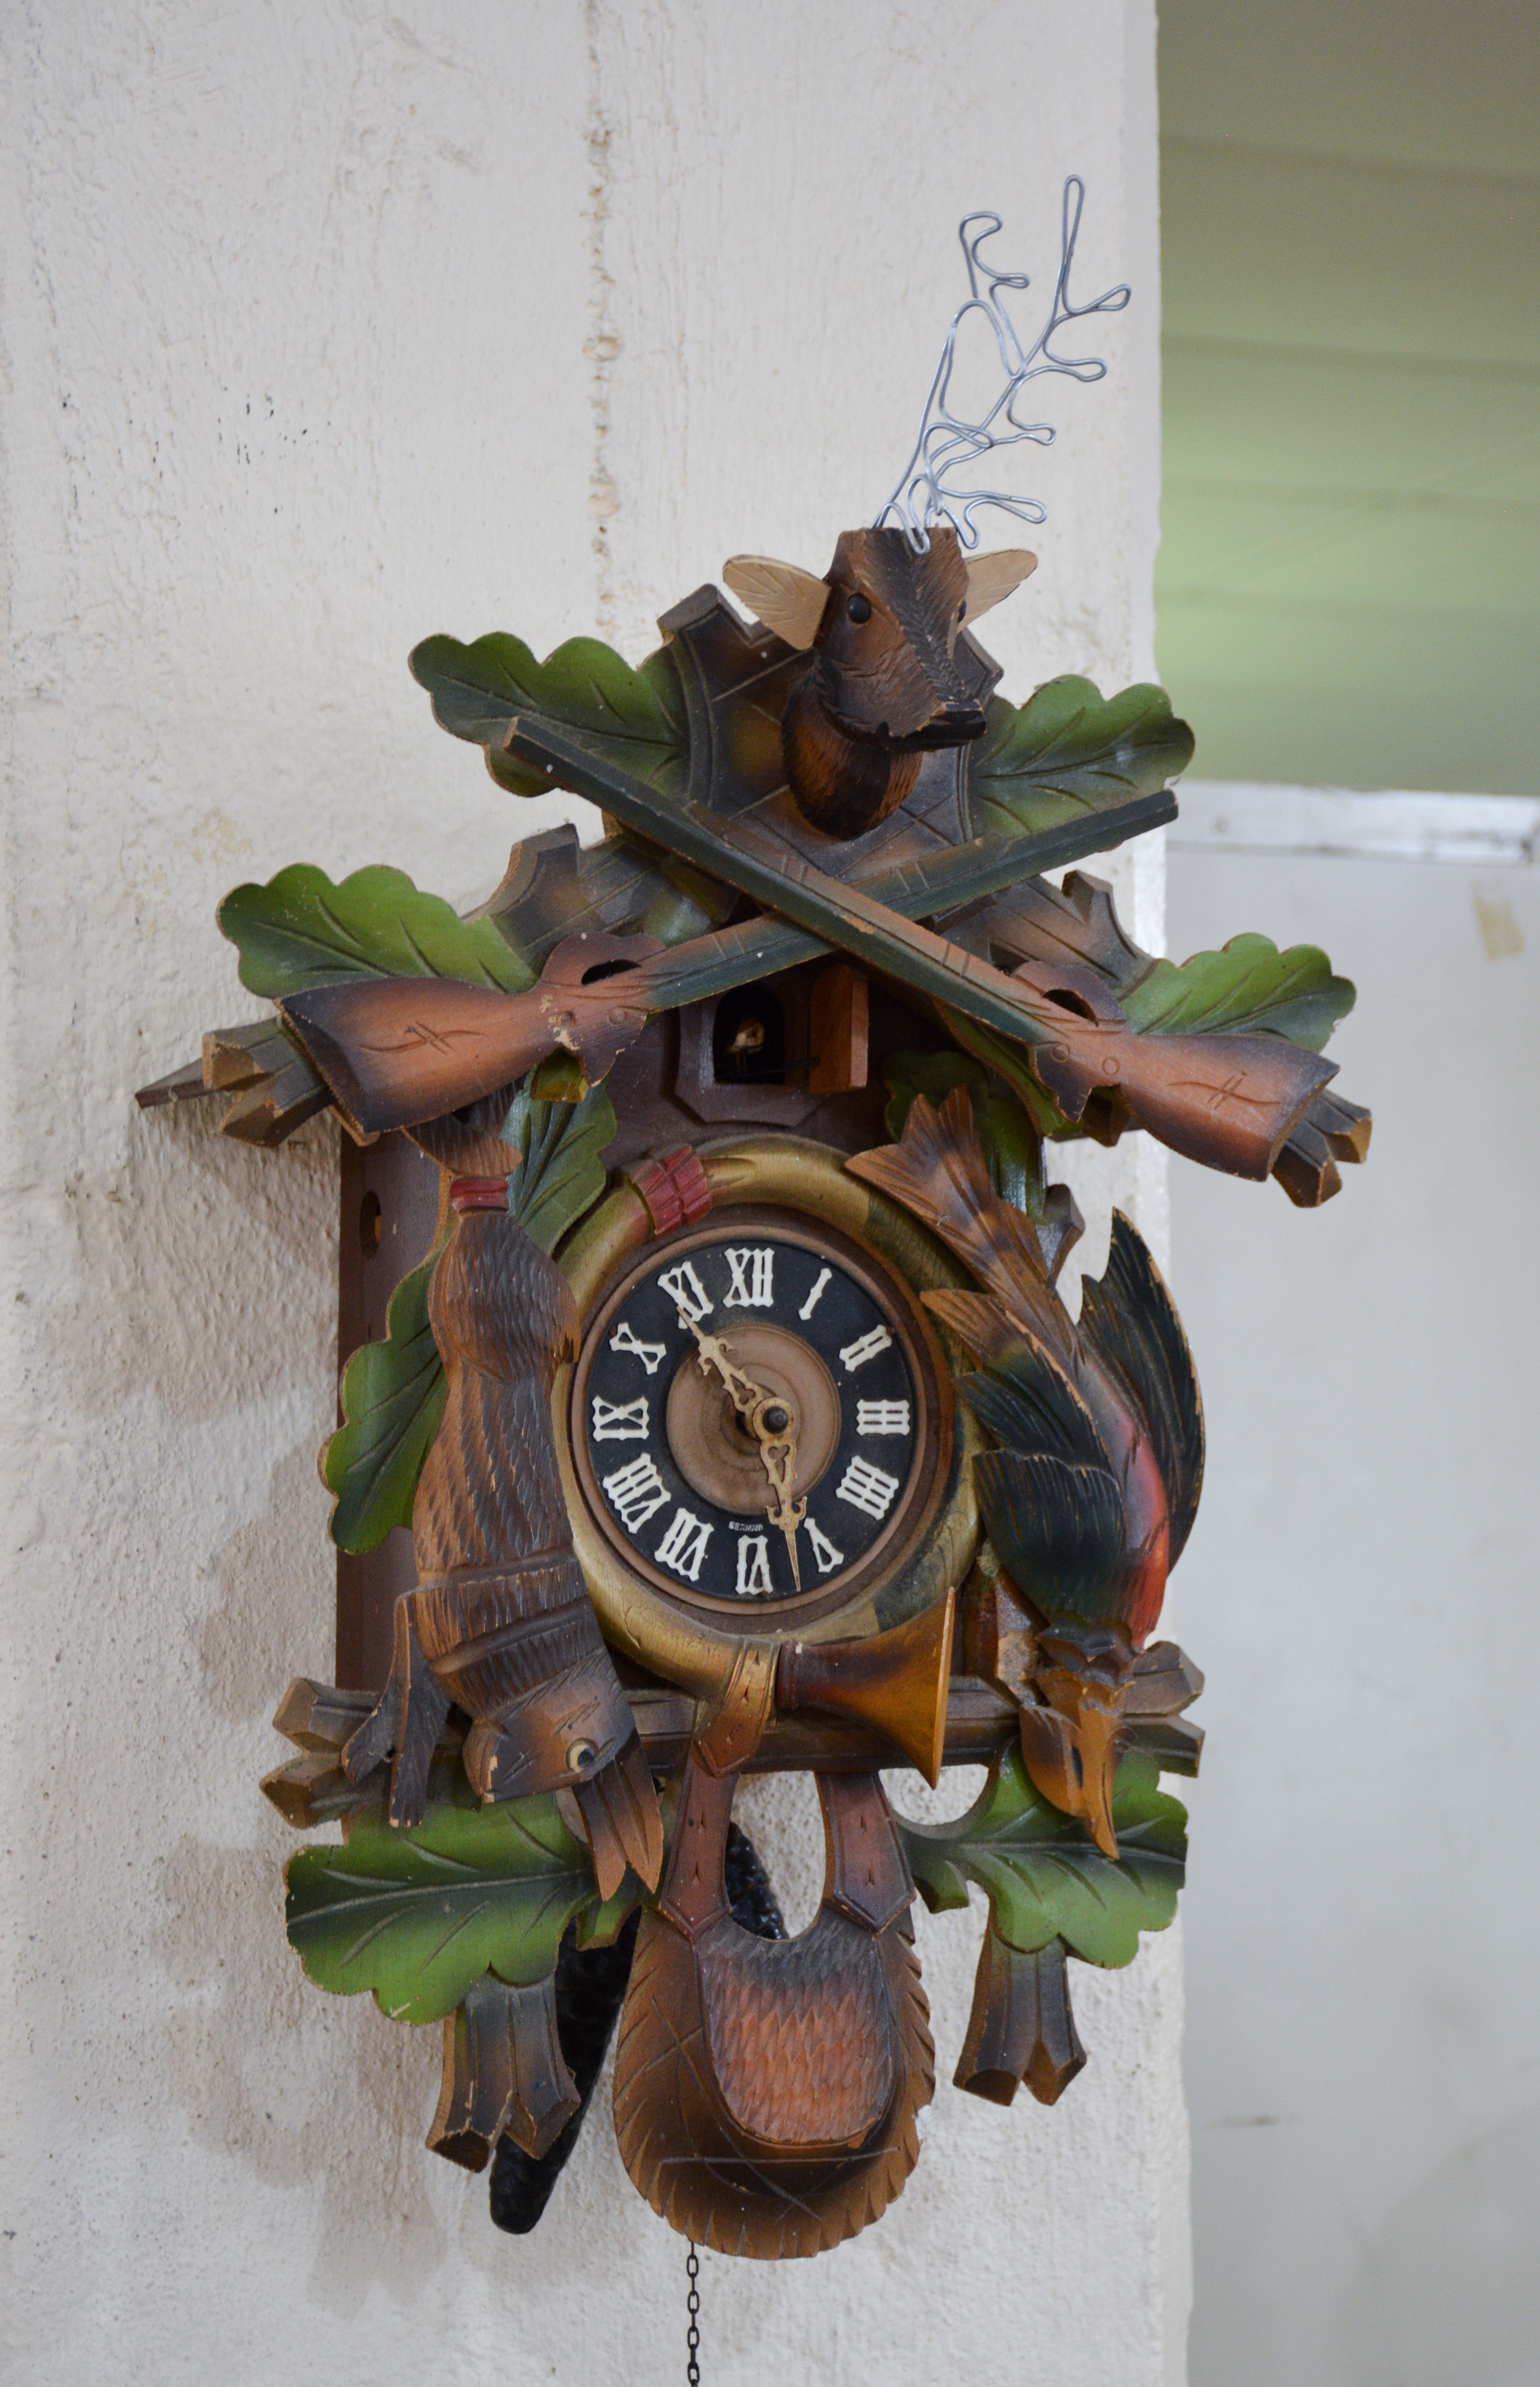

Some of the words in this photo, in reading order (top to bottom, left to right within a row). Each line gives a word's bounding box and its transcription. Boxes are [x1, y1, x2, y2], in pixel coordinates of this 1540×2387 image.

[657, 1261, 714, 1329] XI
[722, 1247, 775, 1308] XII
[799, 1268, 832, 1320] I
[609, 1322, 666, 1375] X
[839, 1324, 892, 1372] II
[592, 1396, 649, 1442] IX
[856, 1399, 910, 1436] III
[603, 1452, 672, 1534] VIII
[836, 1455, 899, 1520] IIII
[654, 1507, 714, 1582] VII
[735, 1534, 773, 1595] VI
[804, 1518, 844, 1573] V
